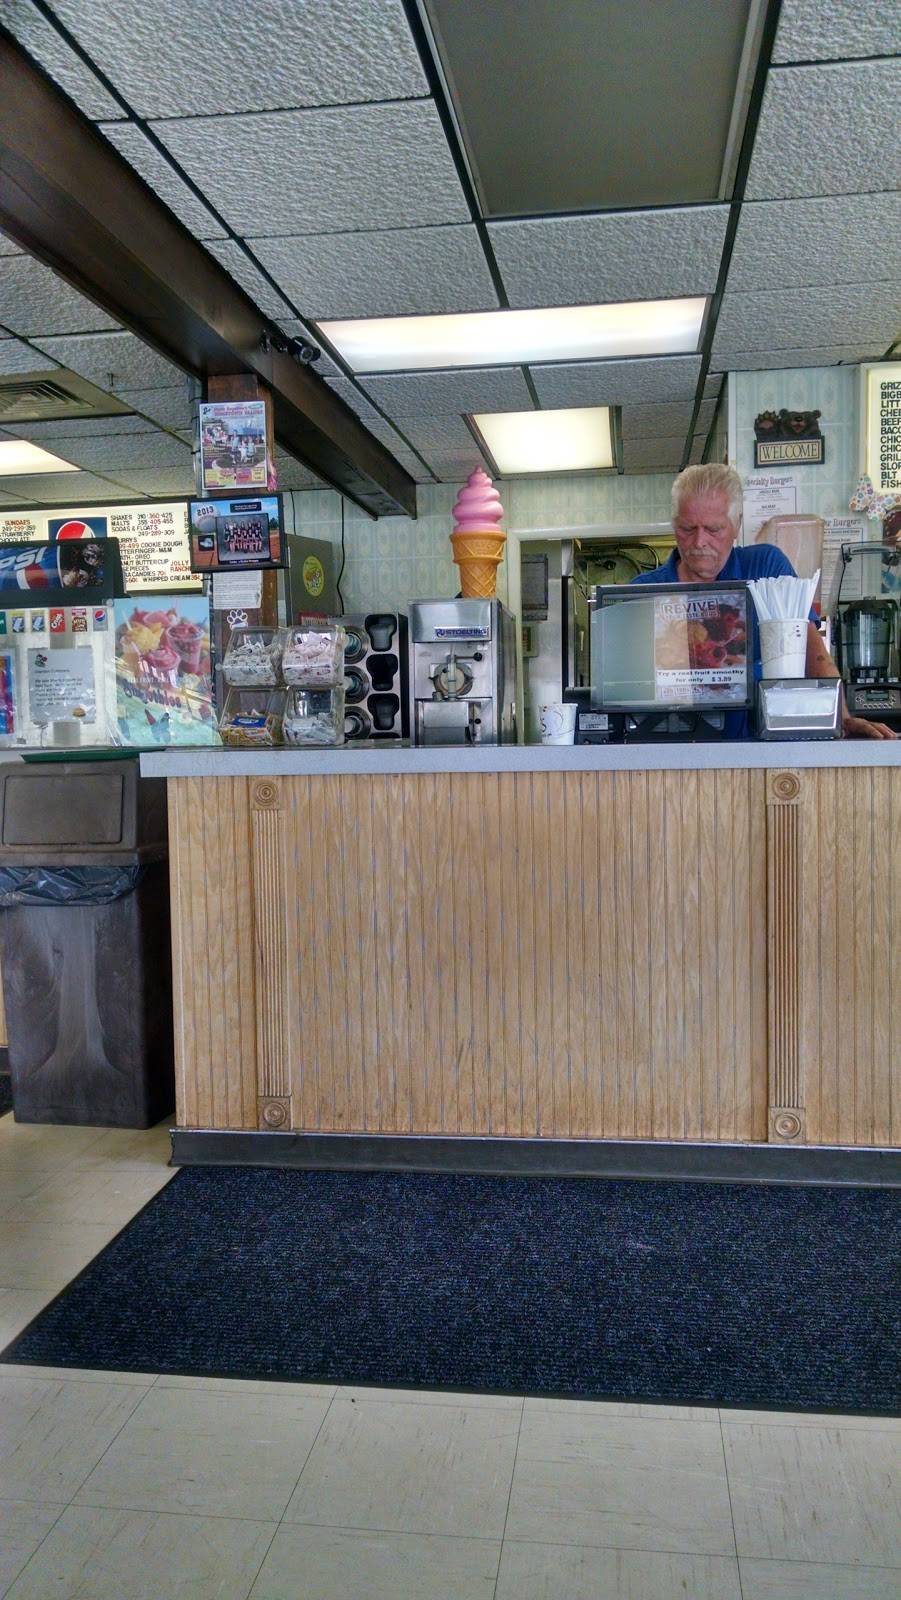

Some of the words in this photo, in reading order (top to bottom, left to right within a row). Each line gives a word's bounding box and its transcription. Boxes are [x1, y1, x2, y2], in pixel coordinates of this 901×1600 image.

[762, 443, 817, 459] WELCOME
[881, 471, 896, 480] BLT
[197, 506, 214, 516] 2013
[664, 600, 716, 615] REVIVE
